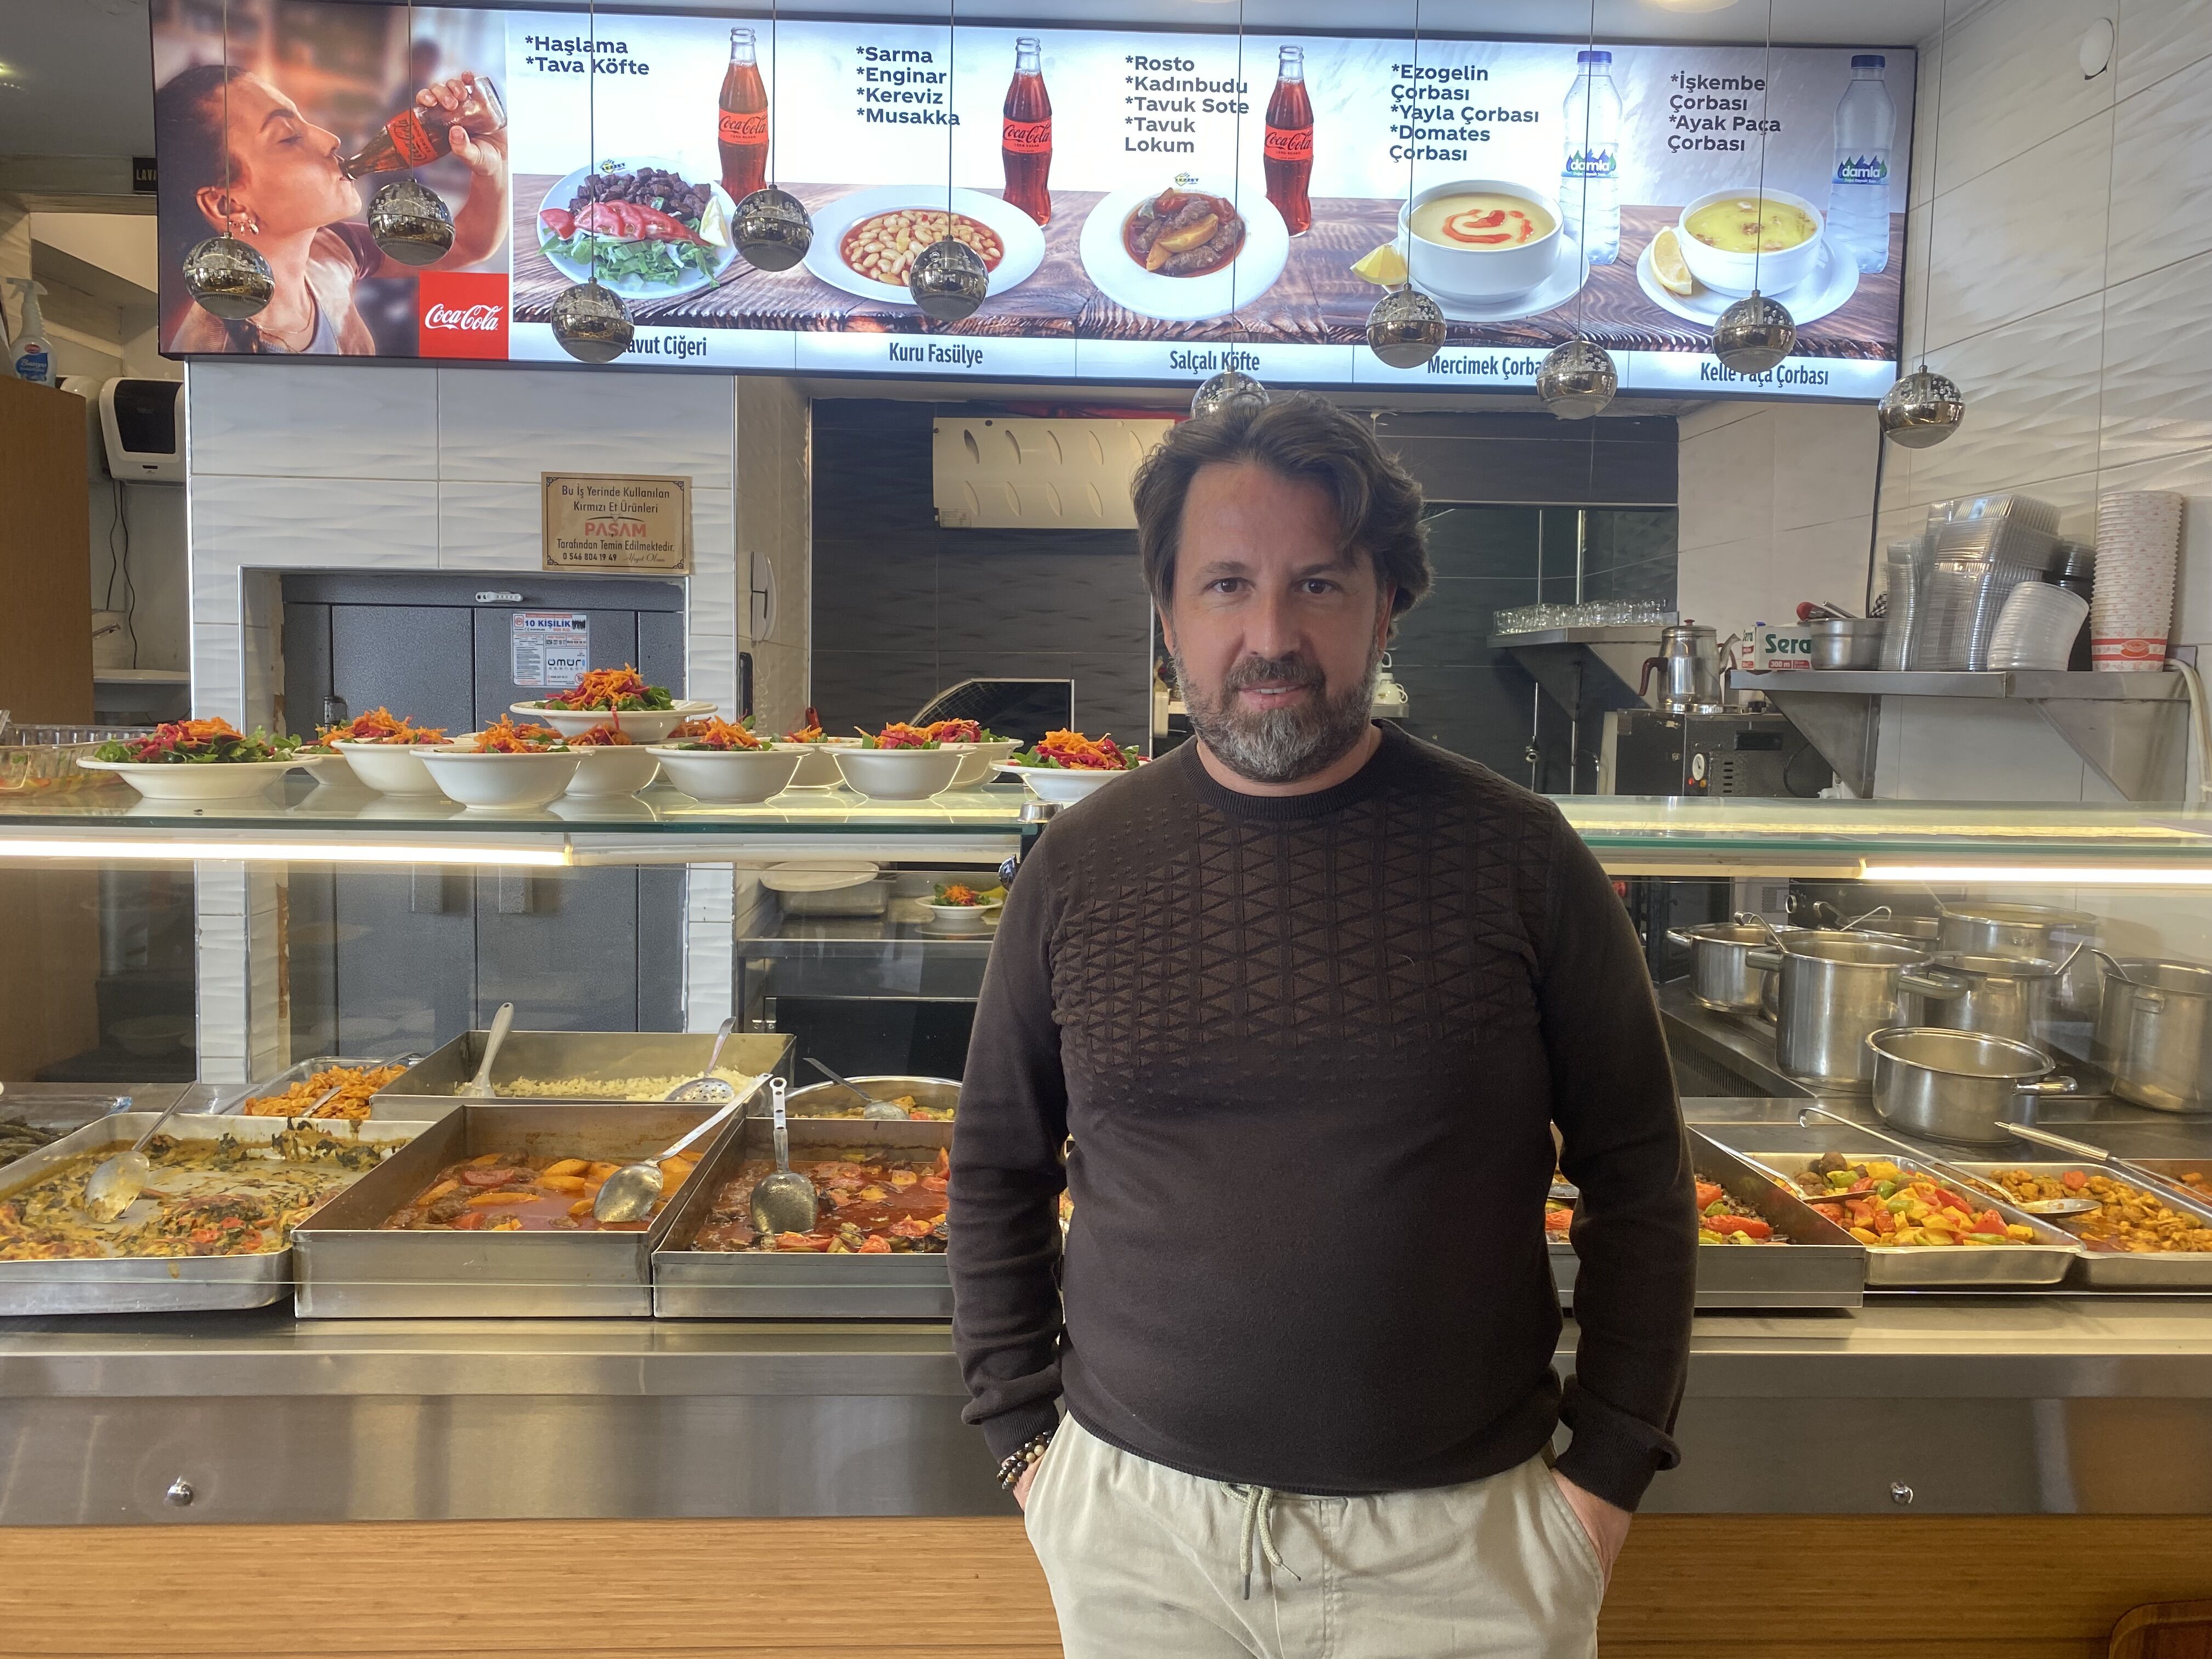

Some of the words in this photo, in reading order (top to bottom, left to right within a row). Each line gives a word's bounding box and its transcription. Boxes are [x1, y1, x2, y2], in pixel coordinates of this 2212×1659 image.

[592, 58, 650, 75] Köfte
[1391, 84, 1469, 103] Çorbası
[1202, 98, 1249, 114] Sote
[1669, 94, 1747, 113] Çorbası
[1461, 106, 1539, 125] Çorbası
[1733, 116, 1781, 135] Paça
[1125, 137, 1194, 153] Lokum
[1668, 135, 1745, 153] Çorbası
[1390, 145, 1467, 163] Çorbası
[1570, 159, 1610, 171] damla
[1842, 165, 1880, 178] damla
[136, 168, 157, 181] LAVA
[425, 303, 504, 331] Coca-Cola
[623, 336, 660, 354] avut
[664, 335, 707, 359] Ciğeri
[889, 342, 924, 362] Kuru
[928, 344, 983, 368] Fasülye
[1170, 350, 1217, 375] Salçalı
[1221, 351, 1260, 371] Köfte
[1427, 356, 1499, 375] Mercimek
[1502, 357, 1541, 380] Çorba
[1701, 362, 1736, 381] Kelle
[1776, 365, 1829, 388] Çorbası
[562, 486, 573, 495] Bu
[577, 483, 584, 499] İş
[587, 486, 620, 497] Yerinde
[623, 487, 670, 498] Kullanılan
[574, 501, 606, 512] Kırmızı
[610, 502, 618, 512] Et
[620, 499, 658, 514] Ürünleri
[557, 538, 597, 550] Tarafından
[600, 539, 623, 550] Temin
[625, 540, 675, 552] Edilmektedir.
[538, 618, 571, 629] KİŞİLİK
[1765, 634, 1811, 654] Sera
